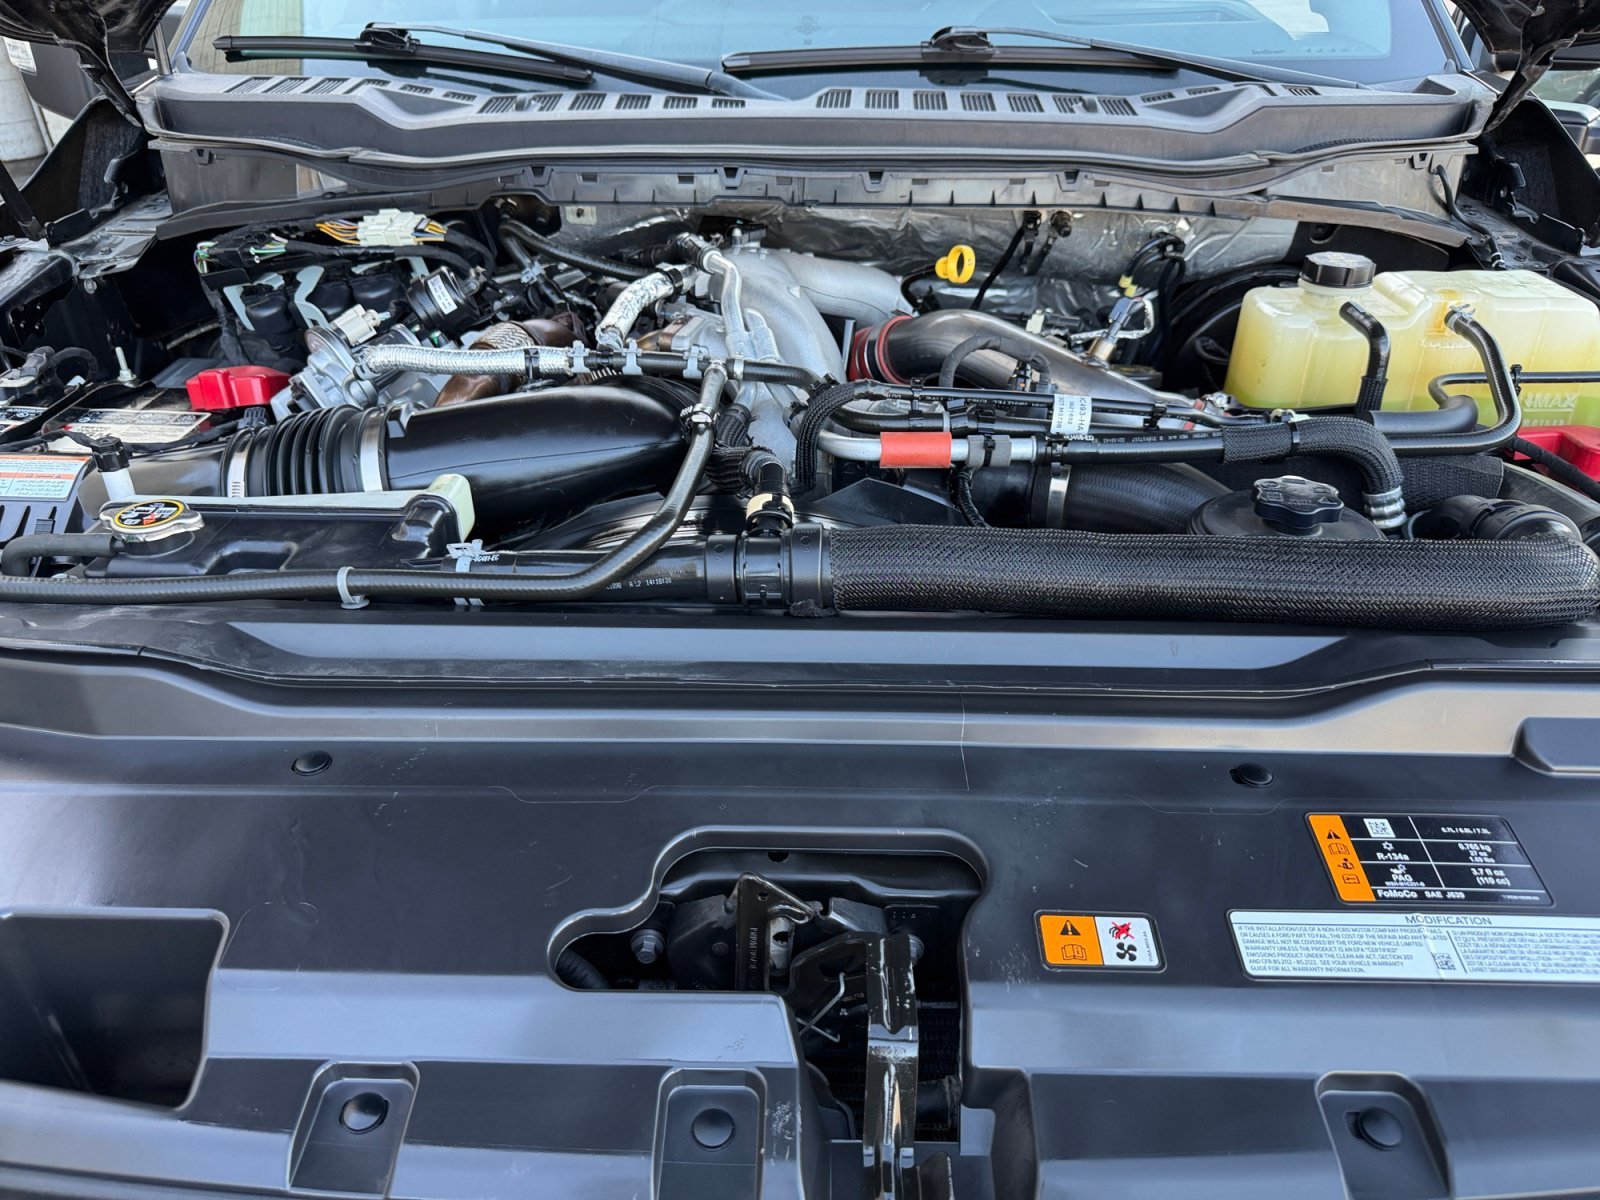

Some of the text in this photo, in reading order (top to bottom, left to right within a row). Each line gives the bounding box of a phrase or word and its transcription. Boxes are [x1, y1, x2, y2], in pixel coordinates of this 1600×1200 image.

[1480, 844, 1492, 852] kg
[1376, 852, 1410, 860] R-134a
[1476, 876, 1511, 886] (110 cc)
[1377, 890, 1418, 898] FoMoCo
[1404, 915, 1492, 925] MODIFICATION
